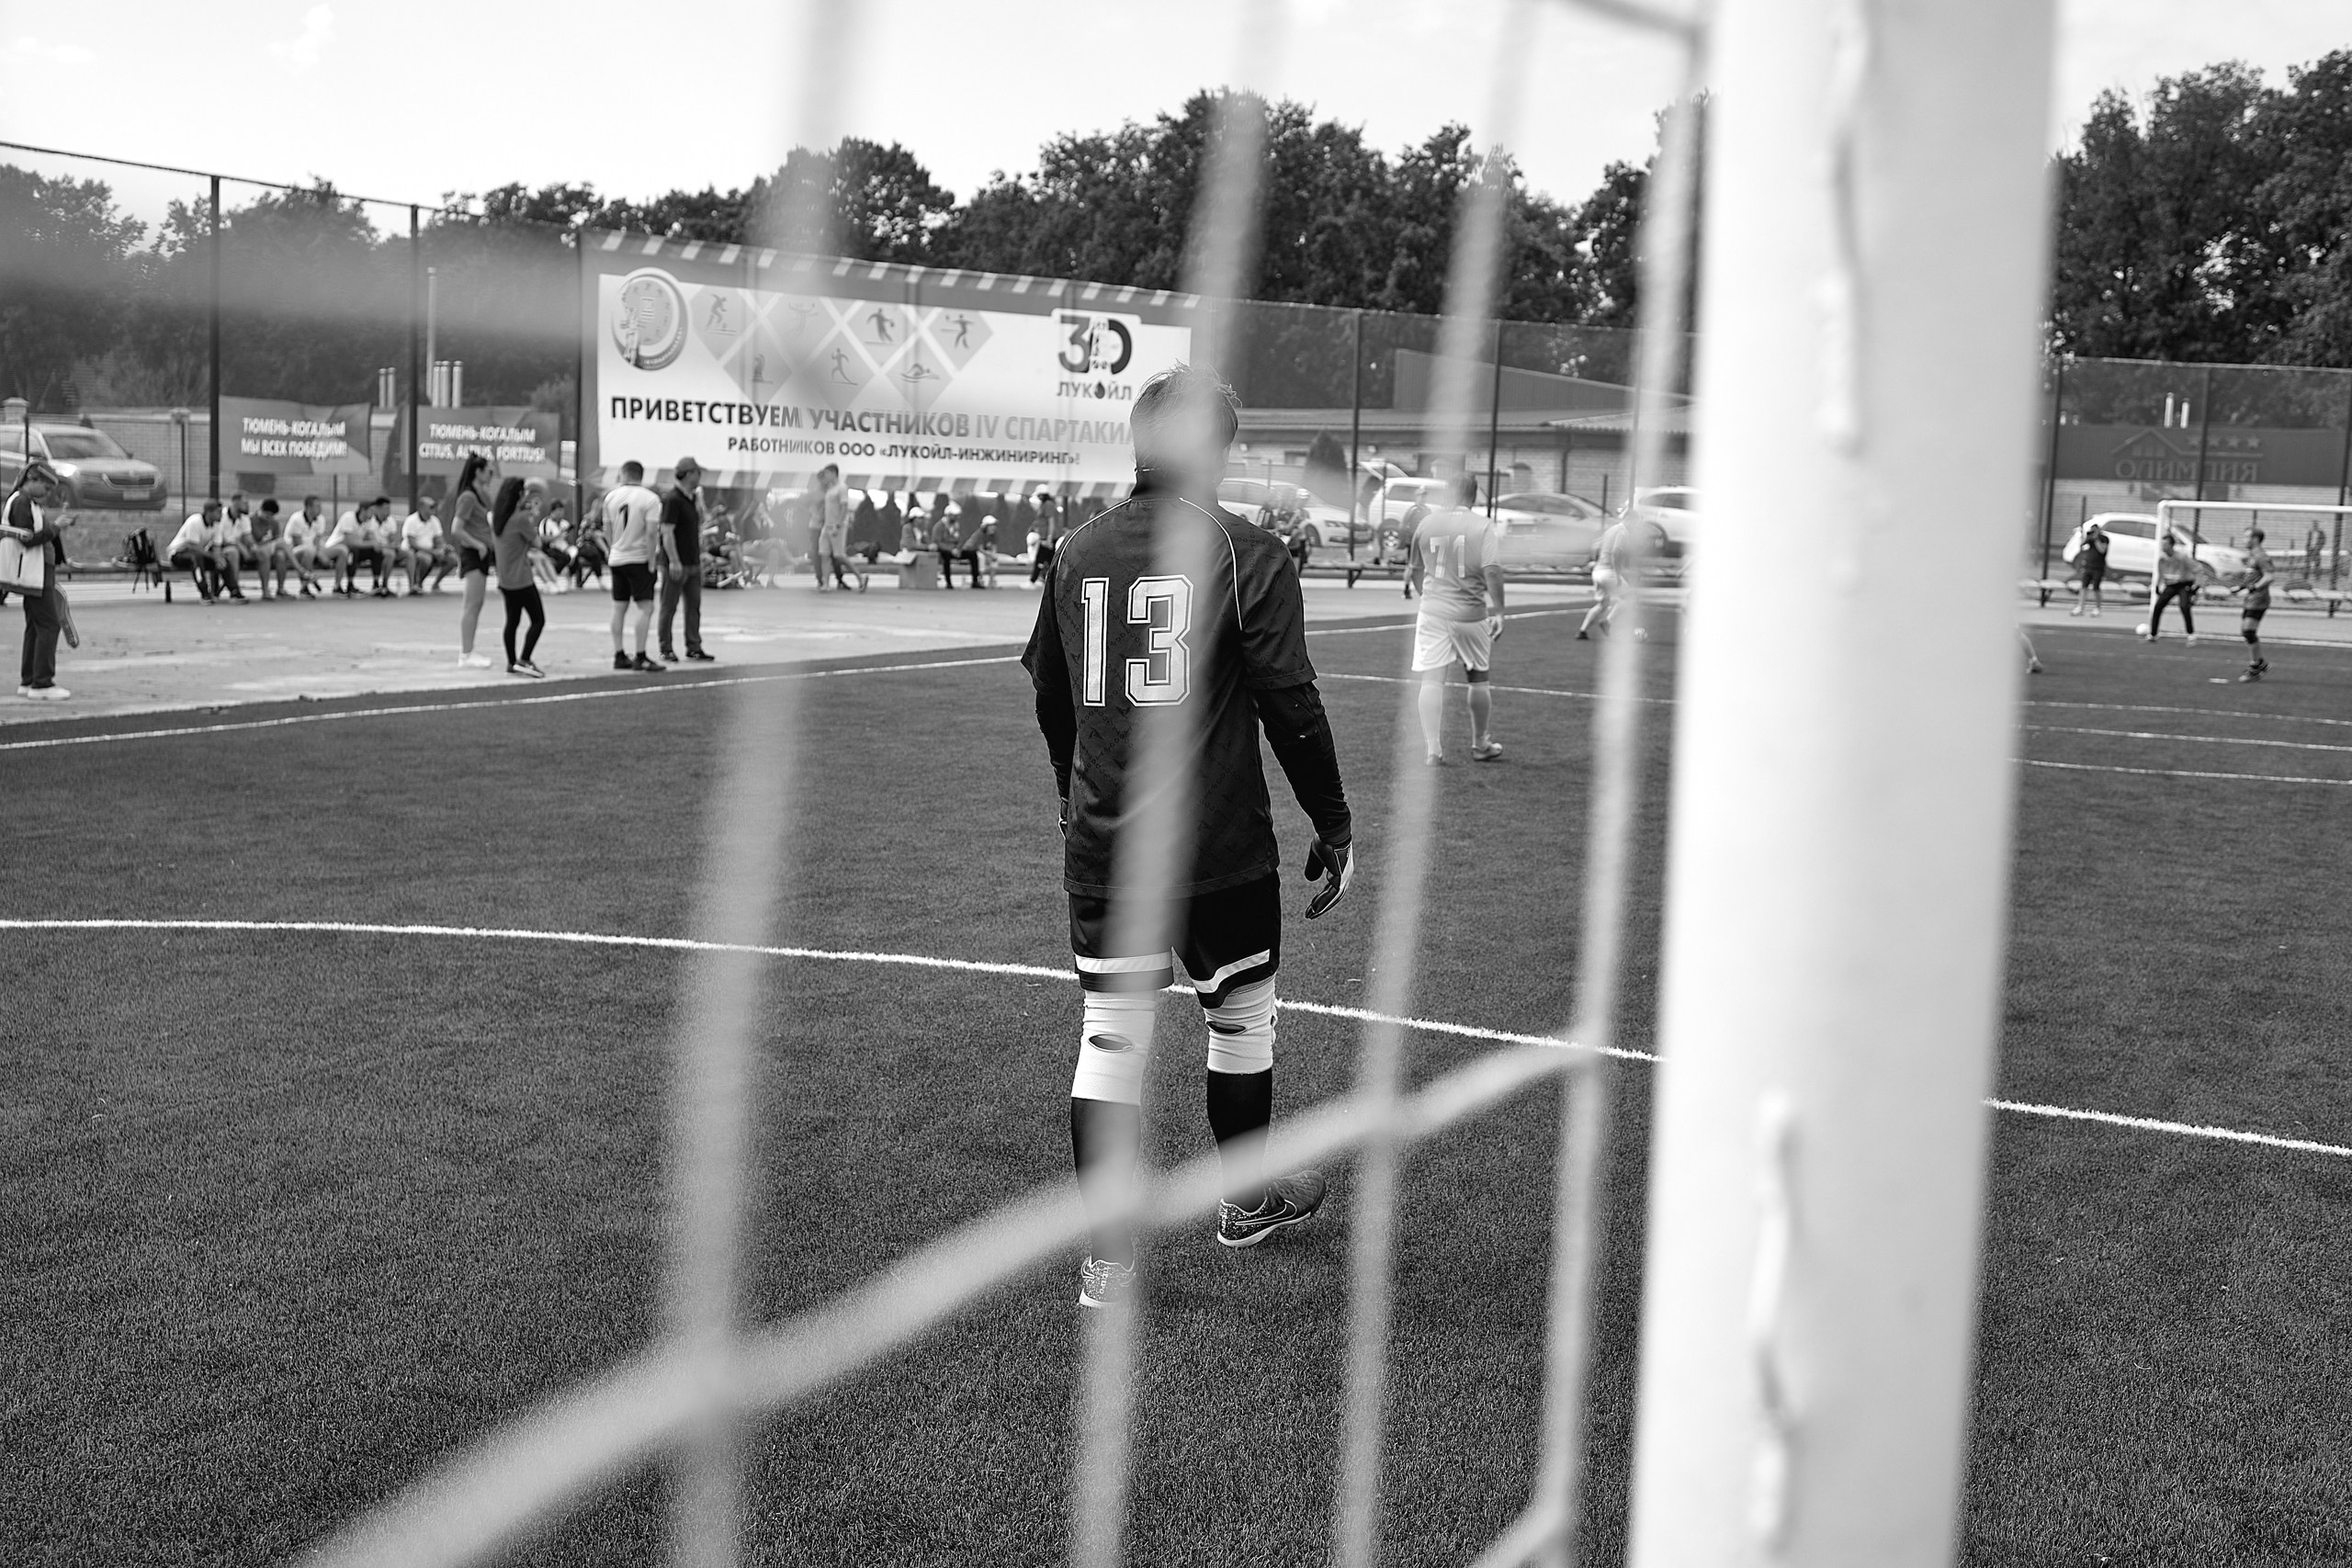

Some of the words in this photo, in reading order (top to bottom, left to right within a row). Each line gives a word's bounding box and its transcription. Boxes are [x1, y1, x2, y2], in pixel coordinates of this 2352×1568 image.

[242, 416, 346, 438] ТЮМЕНЬ-КОГАЛЫМ
[611, 396, 802, 429] ПРИВЕТСТВУЕМ
[809, 407, 970, 438] УЧАСТНИКОВ
[976, 414, 1001, 439] IV
[429, 423, 537, 444] ТЮМЕНЬ-КОГАЛЫМ
[241, 437, 261, 455] МЫ
[261, 439, 288, 457] ВСЕХ
[288, 441, 347, 461] ПОБЕДИМ!
[496, 446, 546, 463] FORTIUS!
[727, 436, 835, 456] РАБОТНИКОВ
[839, 441, 876, 457] ООО
[1430, 534, 1466, 579] 71
[1080, 574, 1193, 707] 13
